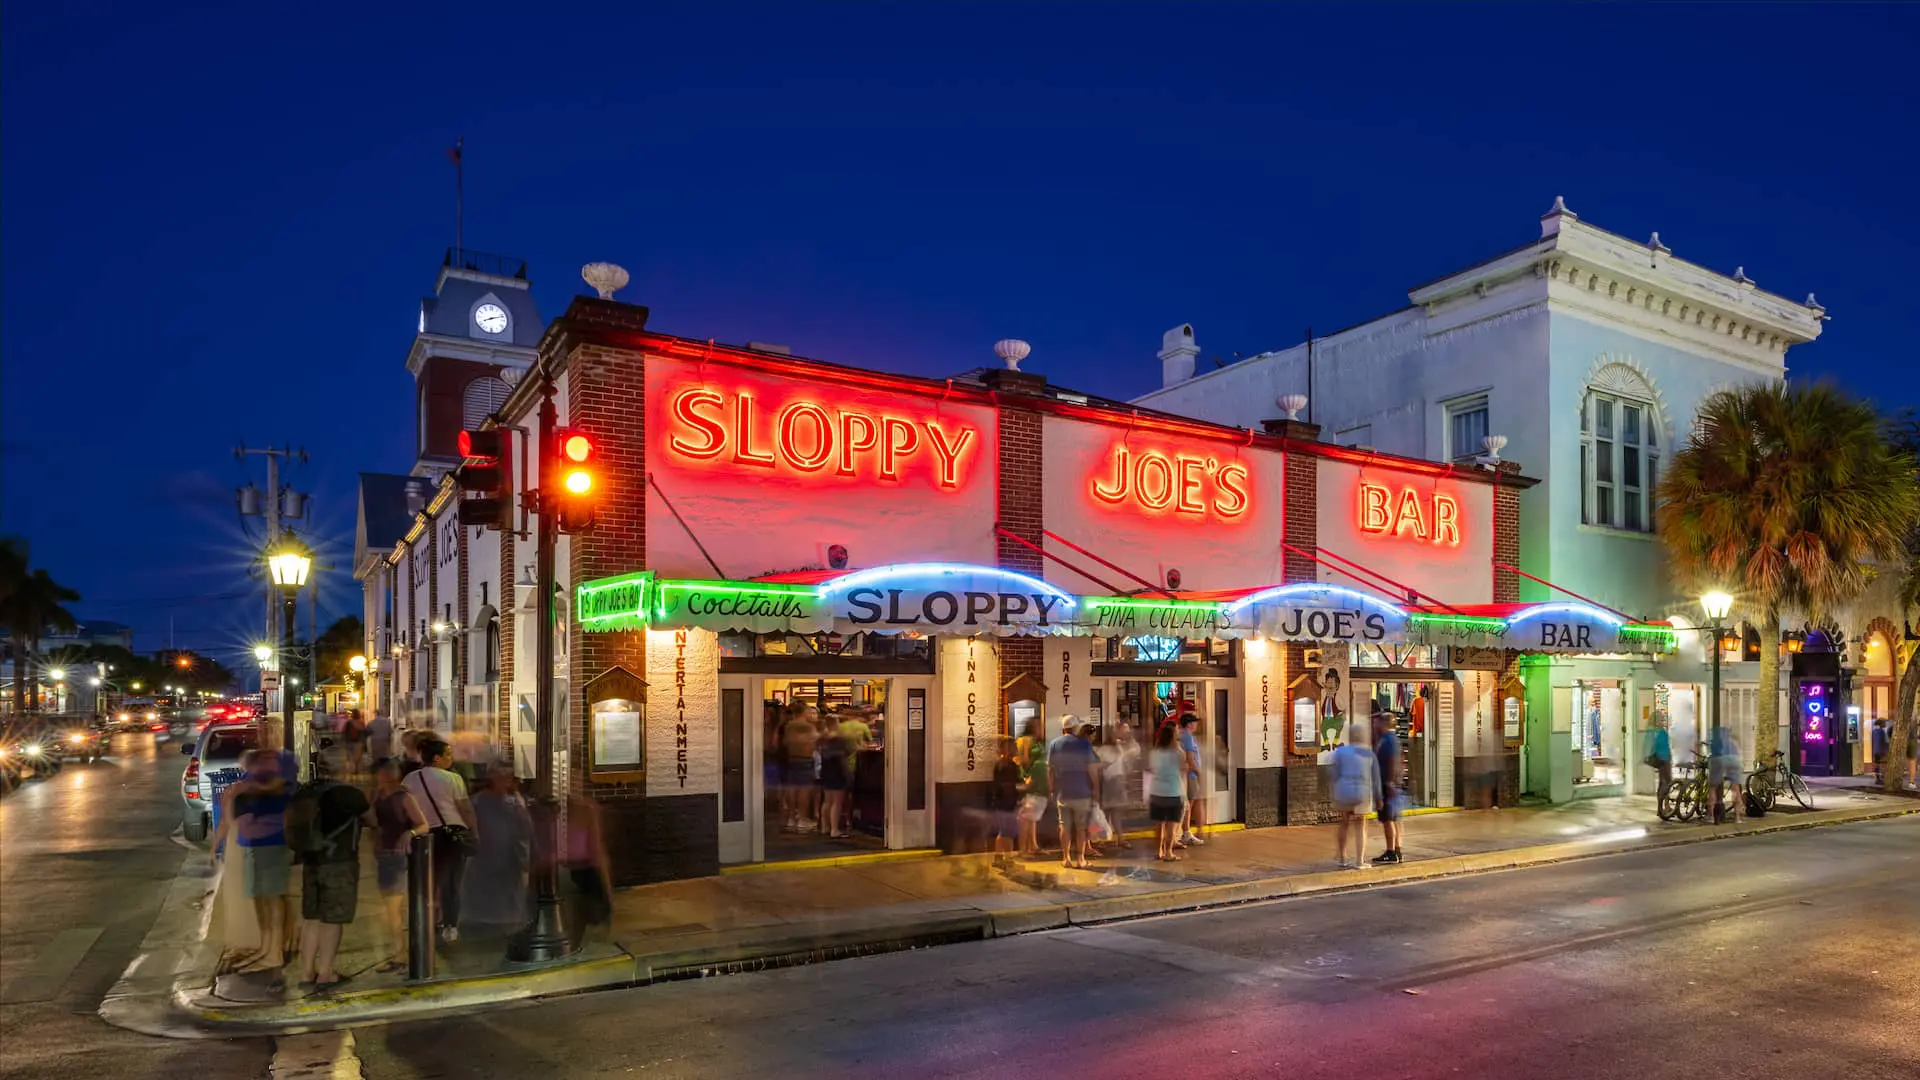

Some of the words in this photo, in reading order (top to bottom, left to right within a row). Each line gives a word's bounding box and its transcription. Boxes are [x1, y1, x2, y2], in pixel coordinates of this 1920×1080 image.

[670, 388, 975, 488] SLOPPY
[1092, 448, 1249, 518] JOE'S
[1360, 482, 1460, 545] BAR
[688, 593, 810, 618] Cocktails
[847, 588, 1067, 627] SLOPPY
[1149, 607, 1236, 629] COLADAS
[1281, 607, 1386, 640] JOE'S
[1541, 623, 1593, 648] BAR
[1062, 651, 1071, 705] DRAFT
[675, 627, 688, 788] NTERTAINMENT
[1261, 675, 1269, 761] COCKTAILS
[967, 692, 976, 771] COLADAS
